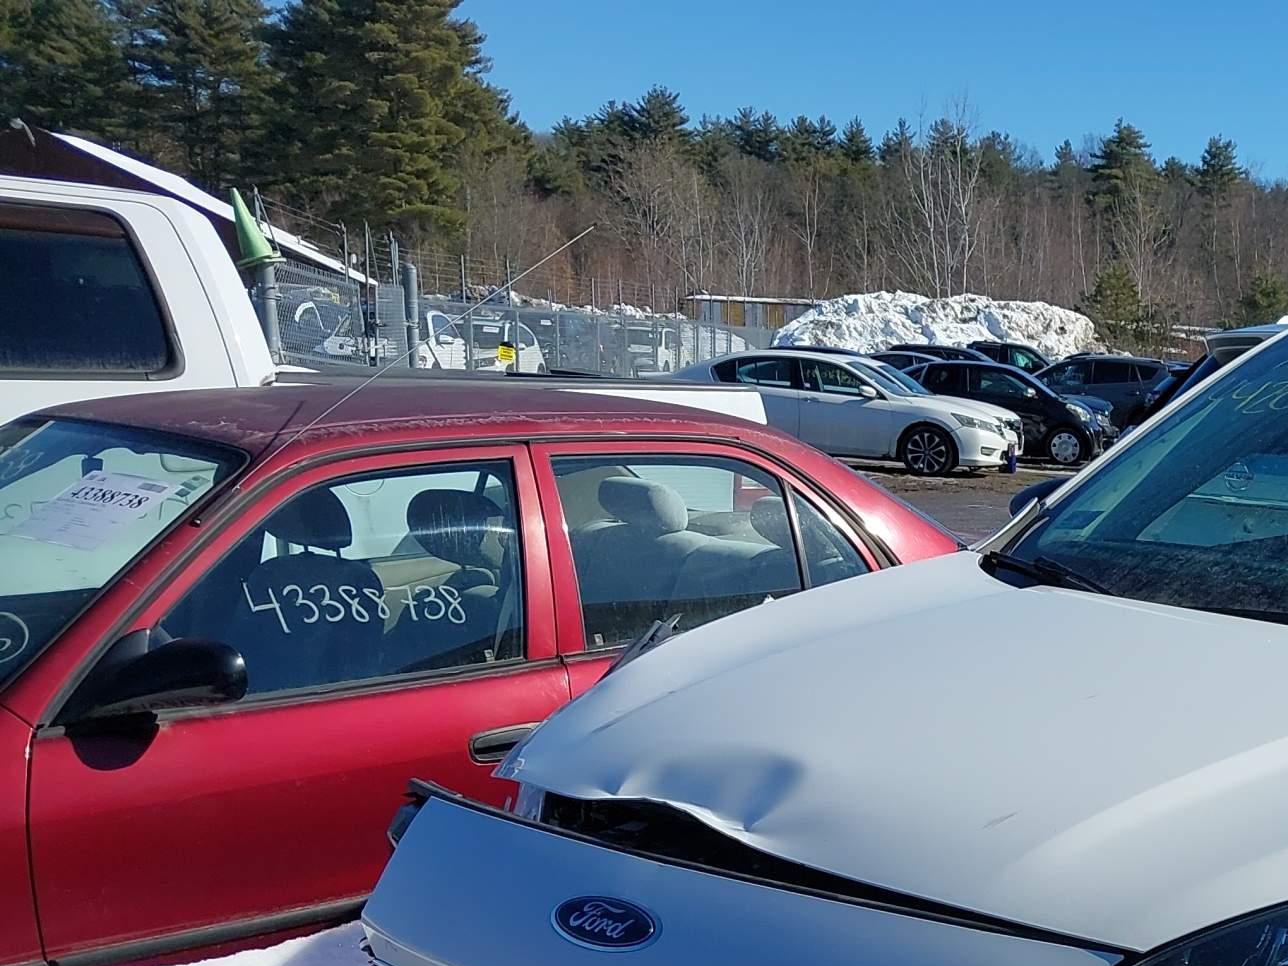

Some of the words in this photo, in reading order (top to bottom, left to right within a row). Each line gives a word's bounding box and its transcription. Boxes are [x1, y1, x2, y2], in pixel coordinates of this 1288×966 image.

[70, 486, 150, 509] 43388738
[242, 580, 467, 634] 43388738
[569, 901, 634, 938] Ford
